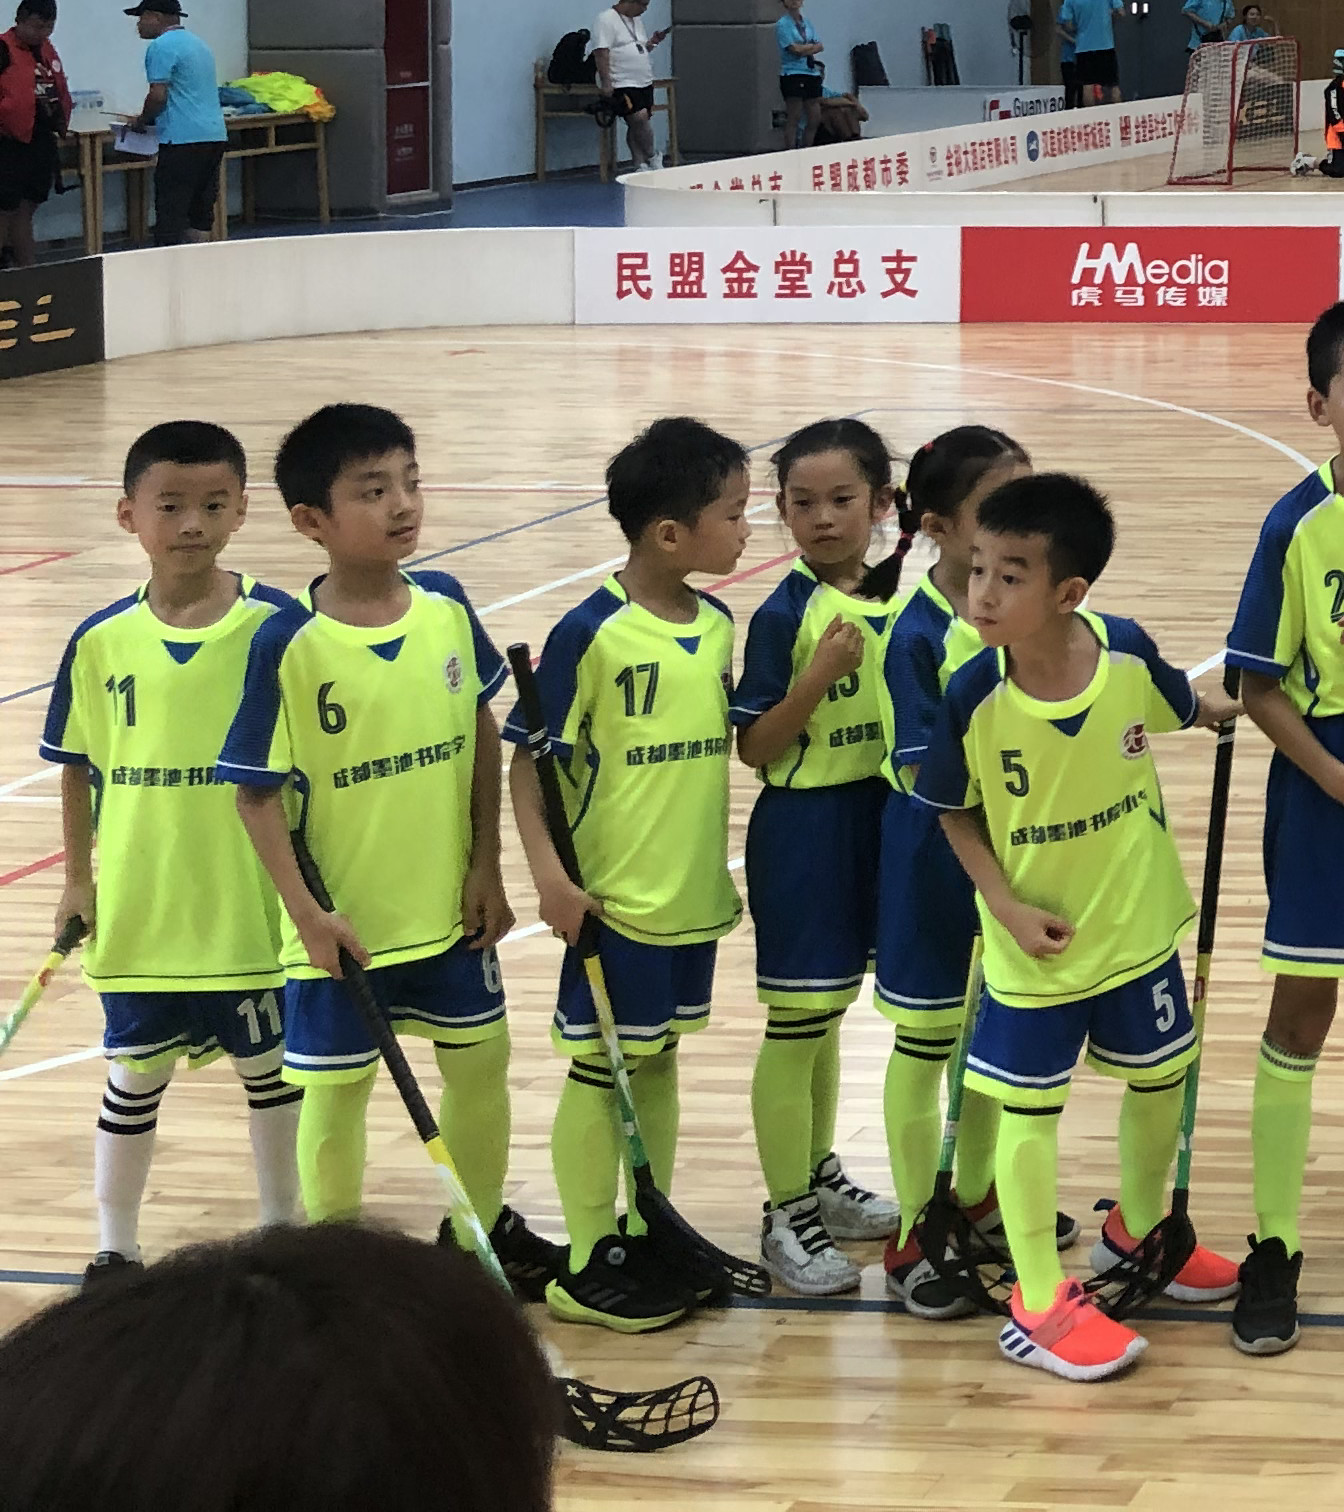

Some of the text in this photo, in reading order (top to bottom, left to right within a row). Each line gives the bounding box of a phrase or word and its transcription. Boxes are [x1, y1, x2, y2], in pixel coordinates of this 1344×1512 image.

[614, 250, 922, 301] 民盟金堂总支
[1070, 242, 1231, 286] HMedia
[1070, 287, 1230, 307] 虎马传媒
[105, 674, 137, 727] 11
[317, 681, 348, 735] 6
[614, 661, 661, 717] 17
[999, 749, 1030, 798] 5
[236, 990, 283, 1045] 11
[1151, 977, 1177, 1034] 5
